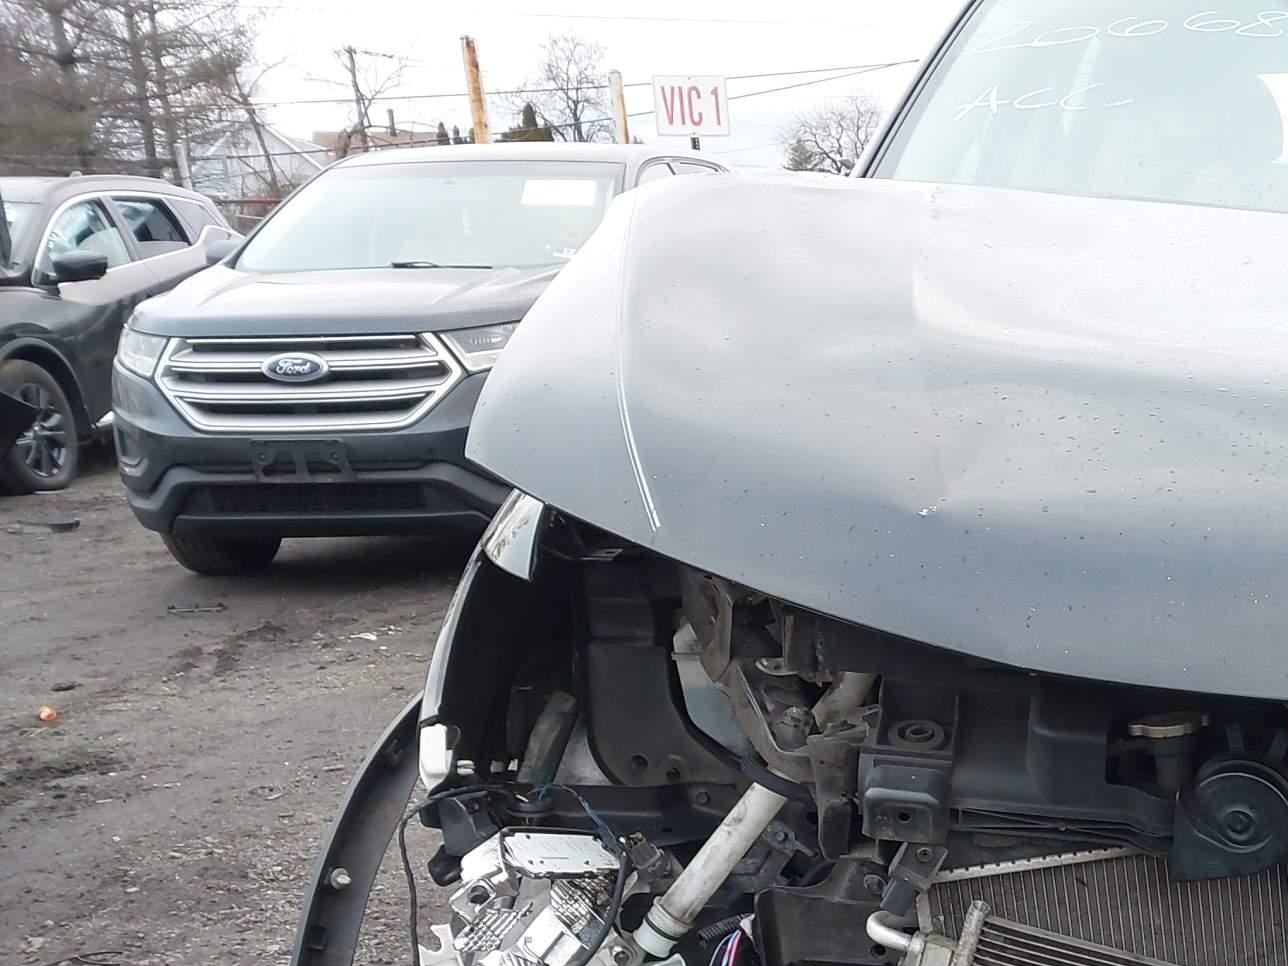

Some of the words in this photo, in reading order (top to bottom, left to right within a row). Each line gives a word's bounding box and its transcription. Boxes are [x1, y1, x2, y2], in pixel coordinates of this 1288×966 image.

[660, 85, 703, 127] VIC
[710, 85, 722, 126] 1
[276, 359, 311, 374] Ford
